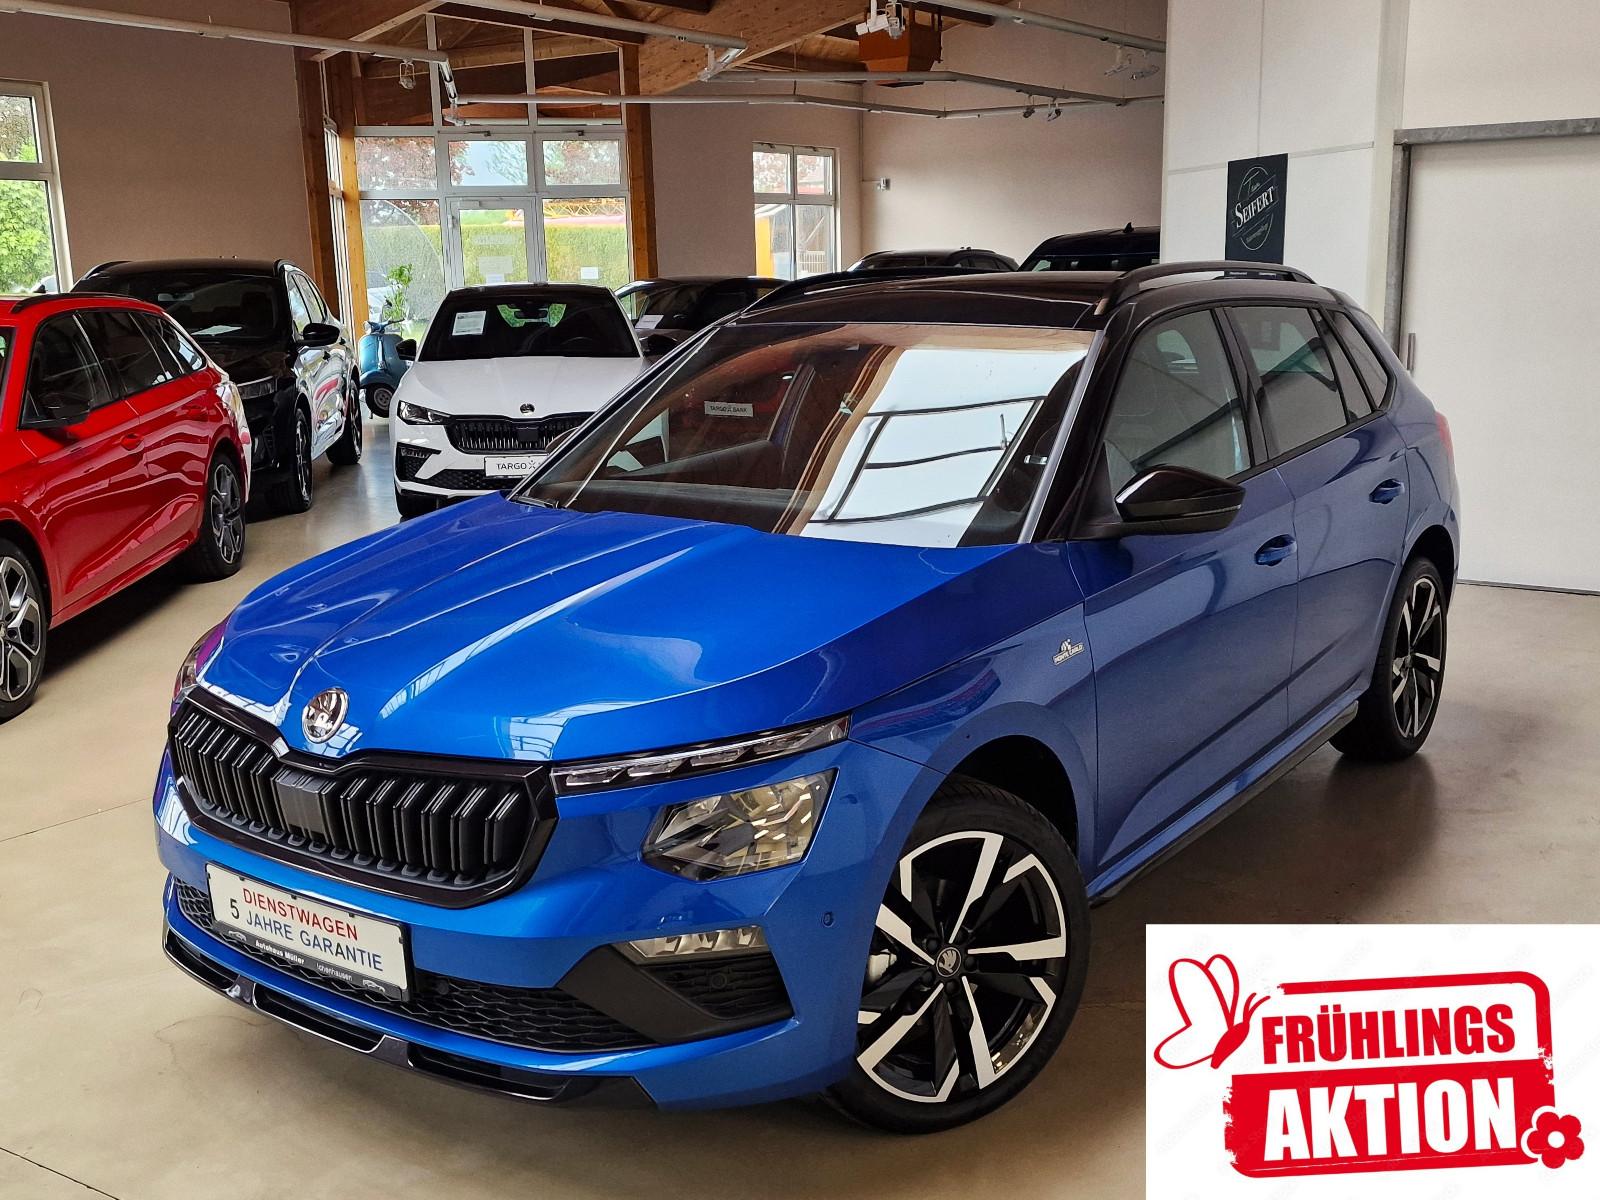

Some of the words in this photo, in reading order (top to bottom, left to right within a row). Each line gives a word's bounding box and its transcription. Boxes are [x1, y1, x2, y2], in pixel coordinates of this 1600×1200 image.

[1235, 186, 1274, 228] SEIFERT
[496, 462, 527, 470] TARGO
[230, 898, 240, 920] 5
[246, 910, 294, 941] JAHRE
[300, 930, 384, 972] GARANTIE
[242, 887, 358, 941] DIENSTWAGEN
[255, 939, 284, 957] Autohaus
[284, 950, 305, 965] Müller
